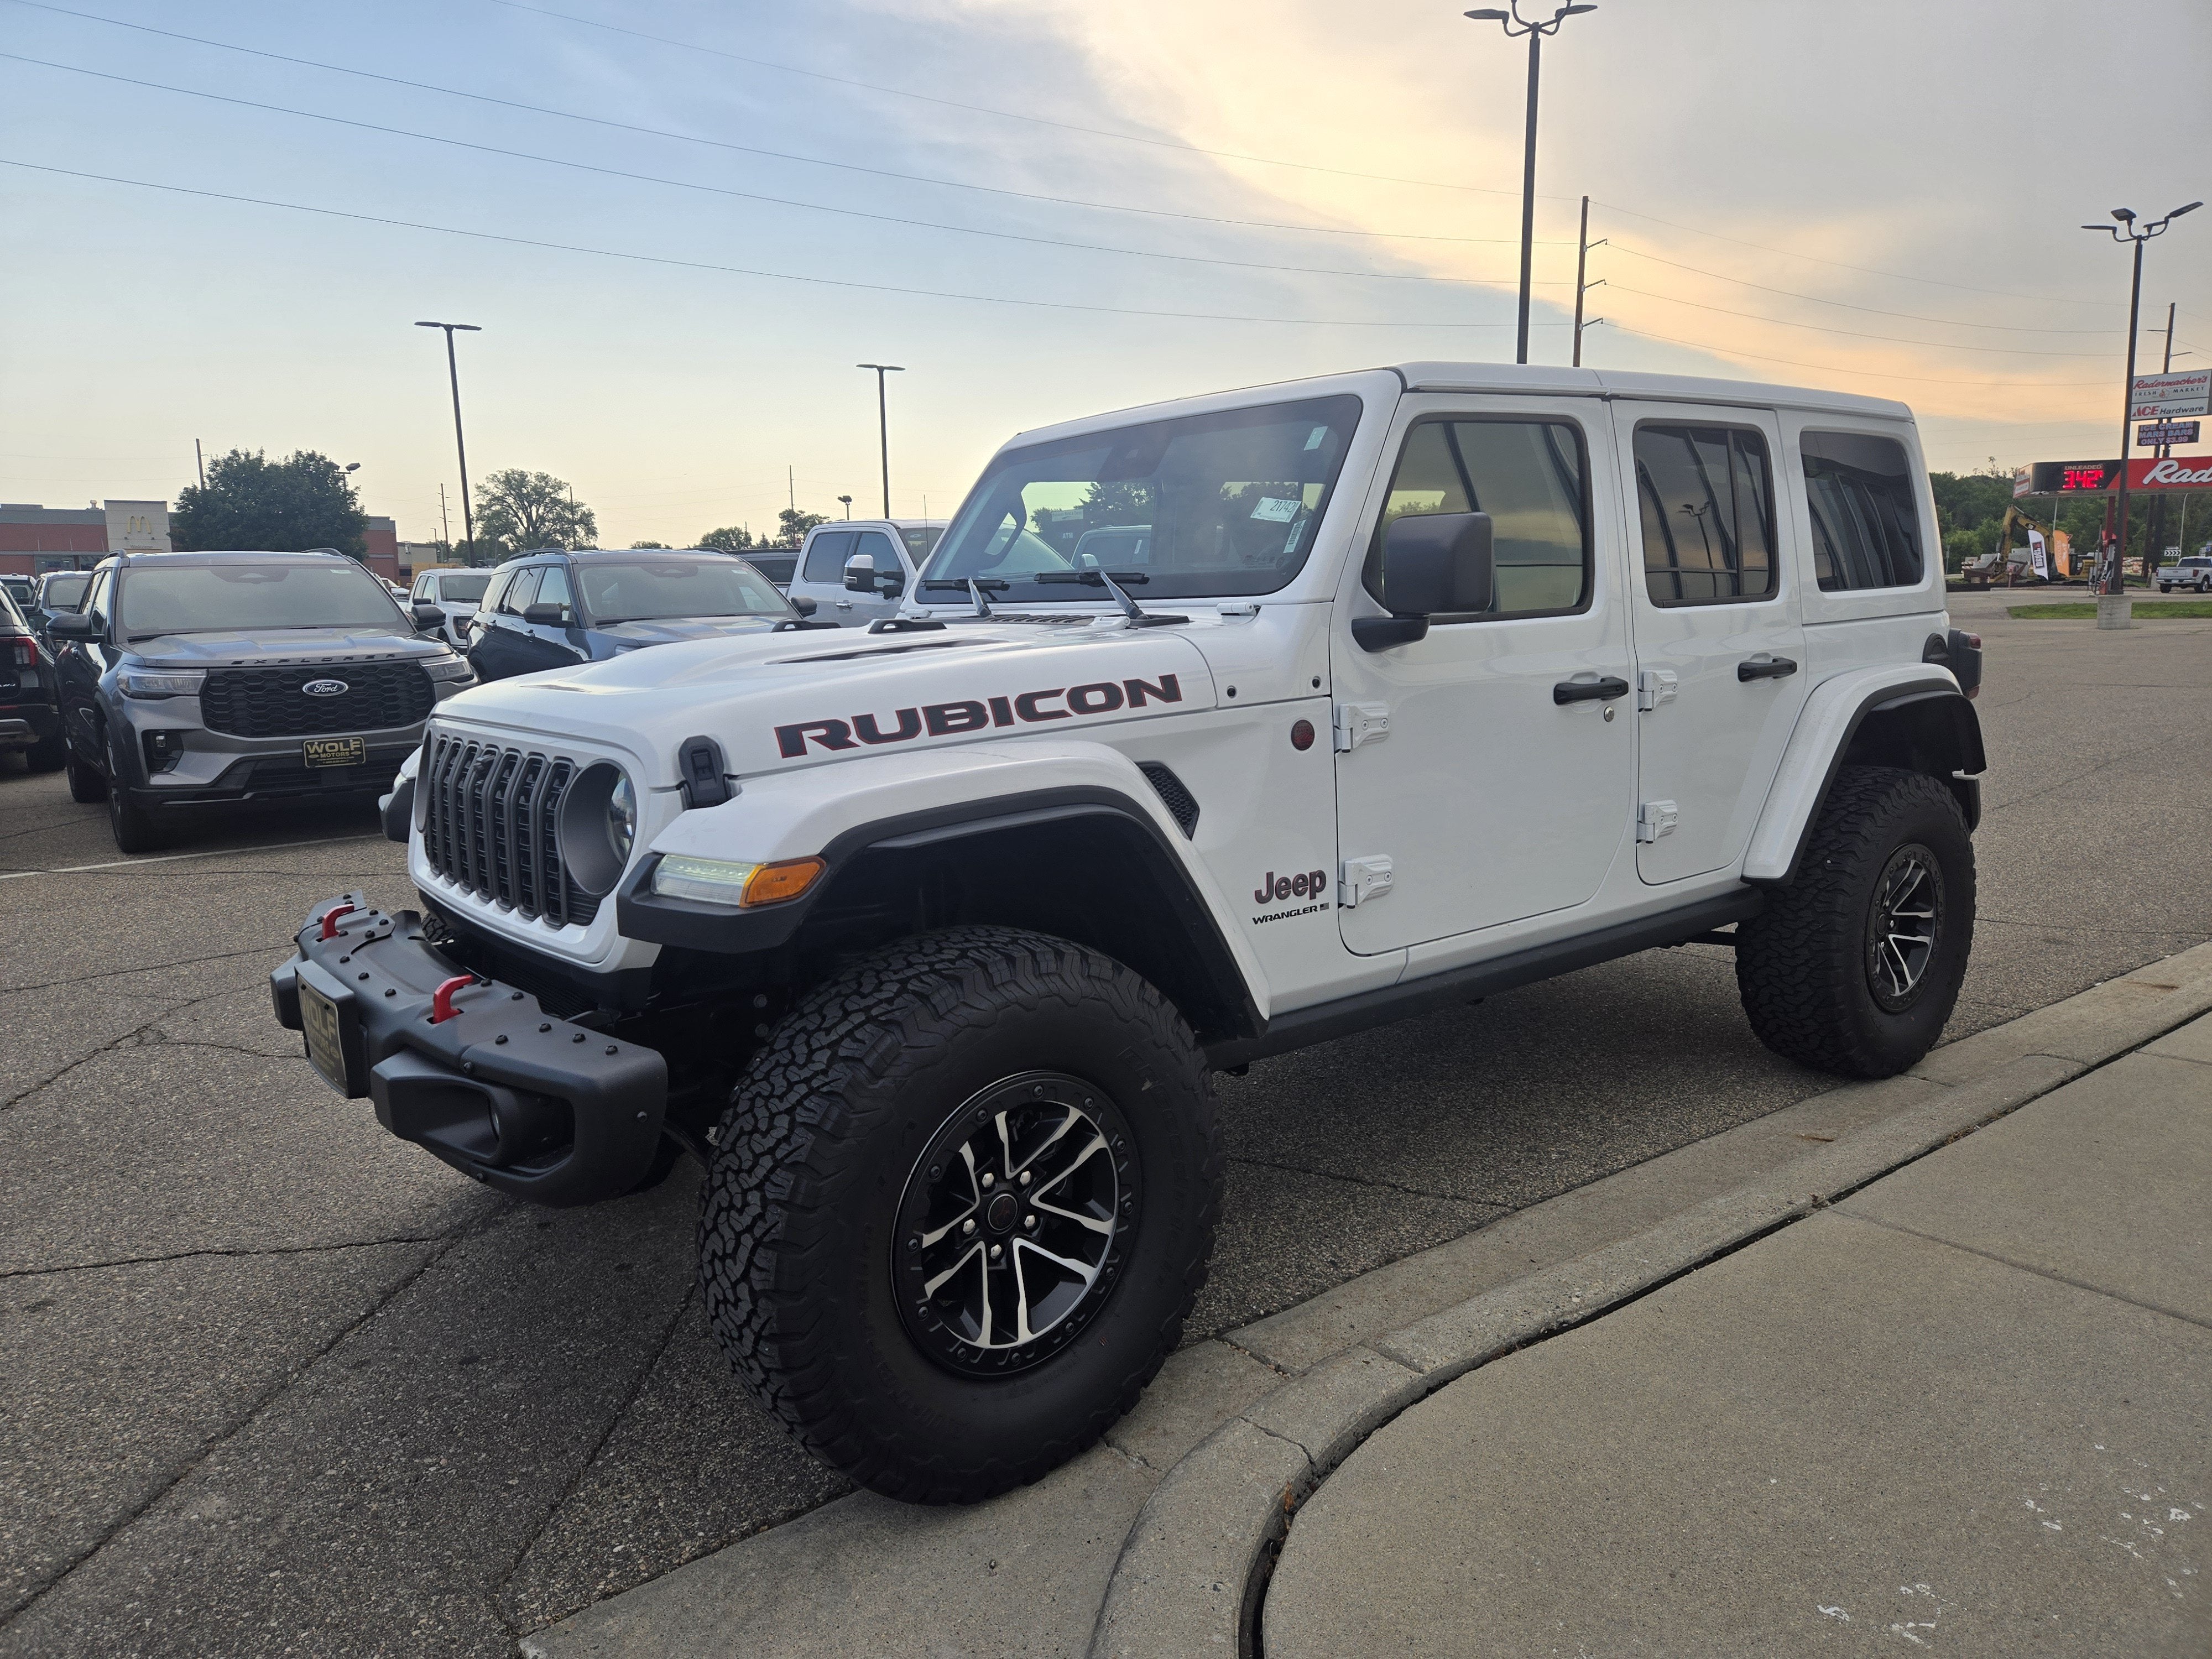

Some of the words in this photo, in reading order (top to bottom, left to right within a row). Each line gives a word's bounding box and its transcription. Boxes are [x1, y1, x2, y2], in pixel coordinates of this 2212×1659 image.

[2133, 375, 2208, 389] Radermacher's
[2131, 405, 2160, 417] ACE
[2159, 406, 2204, 415] Hardware
[1270, 500, 1296, 512] 21742
[231, 654, 395, 665] EXPLORER
[314, 683, 338, 693] Ford
[774, 674, 1183, 759] RUBICON
[307, 741, 361, 753] WOLF
[1255, 870, 1327, 904] Jeep
[1252, 905, 1318, 925] WRANGLER
